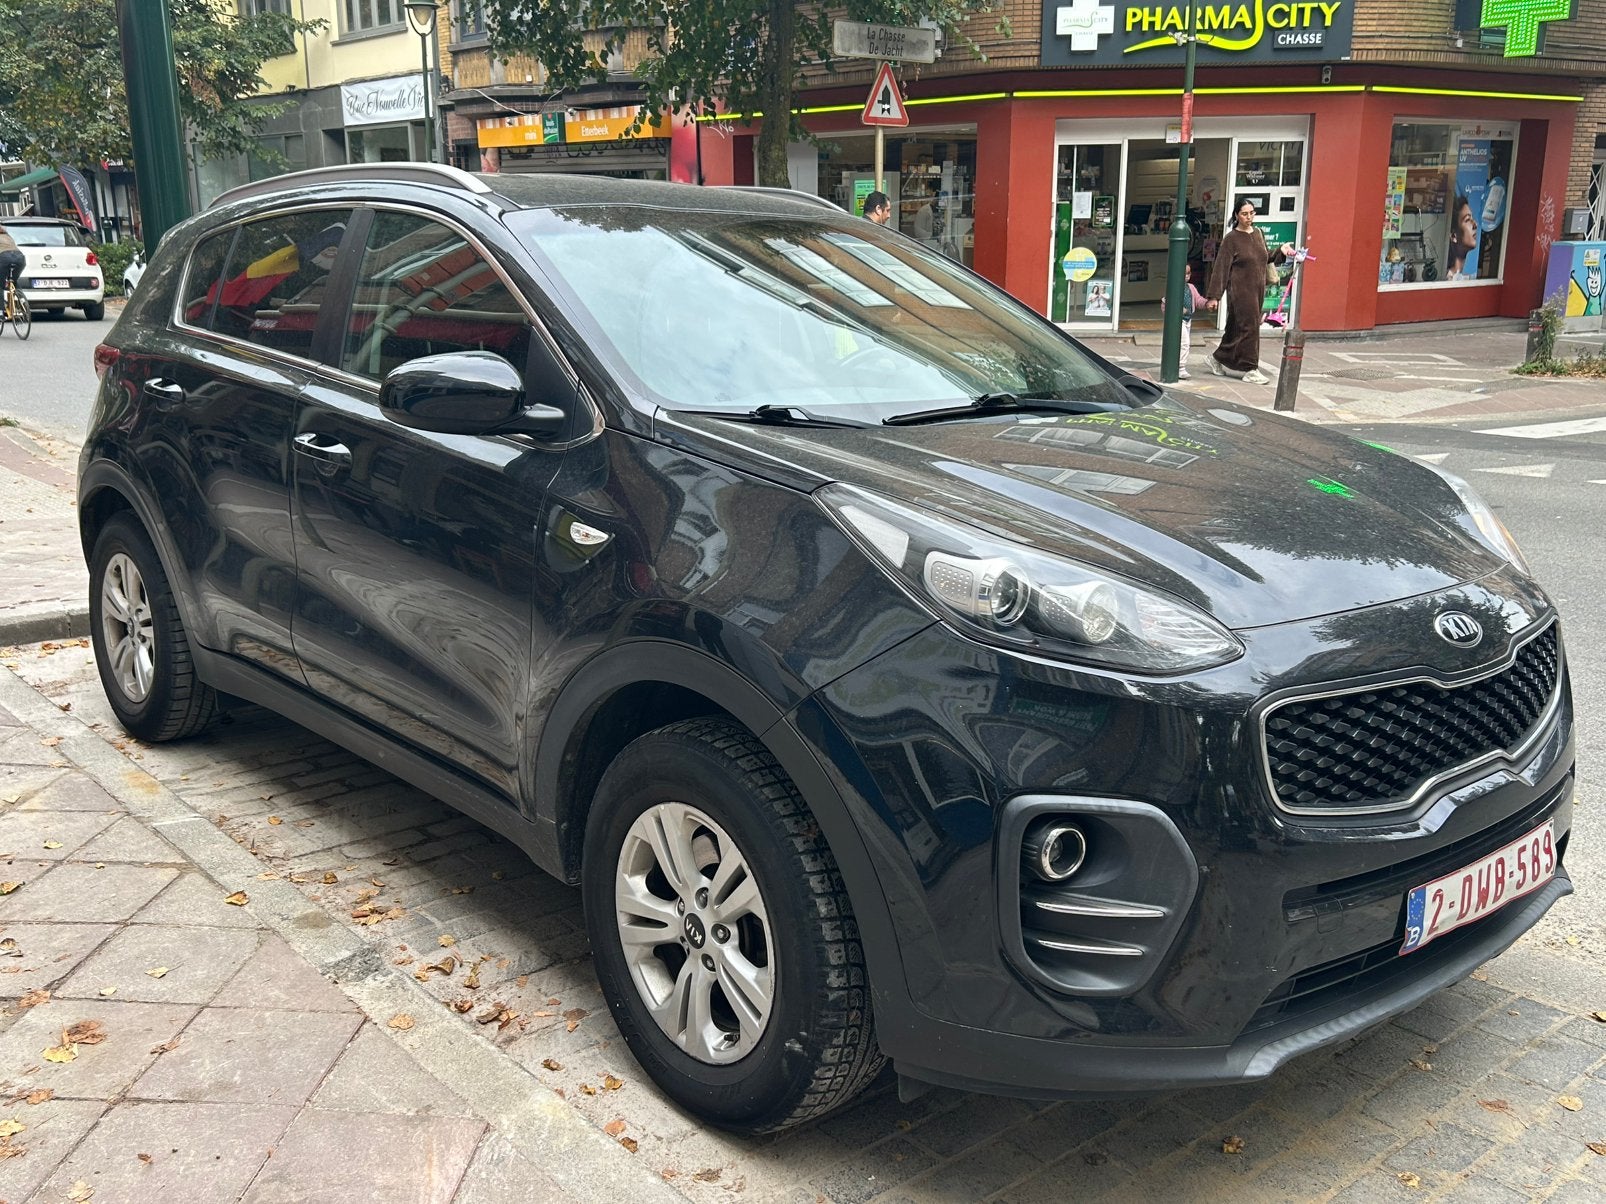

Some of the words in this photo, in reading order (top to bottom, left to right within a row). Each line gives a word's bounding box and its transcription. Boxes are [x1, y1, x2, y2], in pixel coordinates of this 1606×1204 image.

[867, 26, 876, 40] La
[879, 27, 905, 43] Chasse
[1276, 33, 1323, 46] CHASSE
[868, 41, 879, 55] De
[882, 43, 904, 57] Jacht
[366, 88, 407, 116] Nouvelle
[525, 130, 537, 140] mini
[581, 124, 609, 137] Etterbeek
[1440, 614, 1479, 640] KIA
[1426, 829, 1555, 936] 2-DWB-589
[685, 918, 703, 945] KIA
[1407, 926, 1421, 947] B
